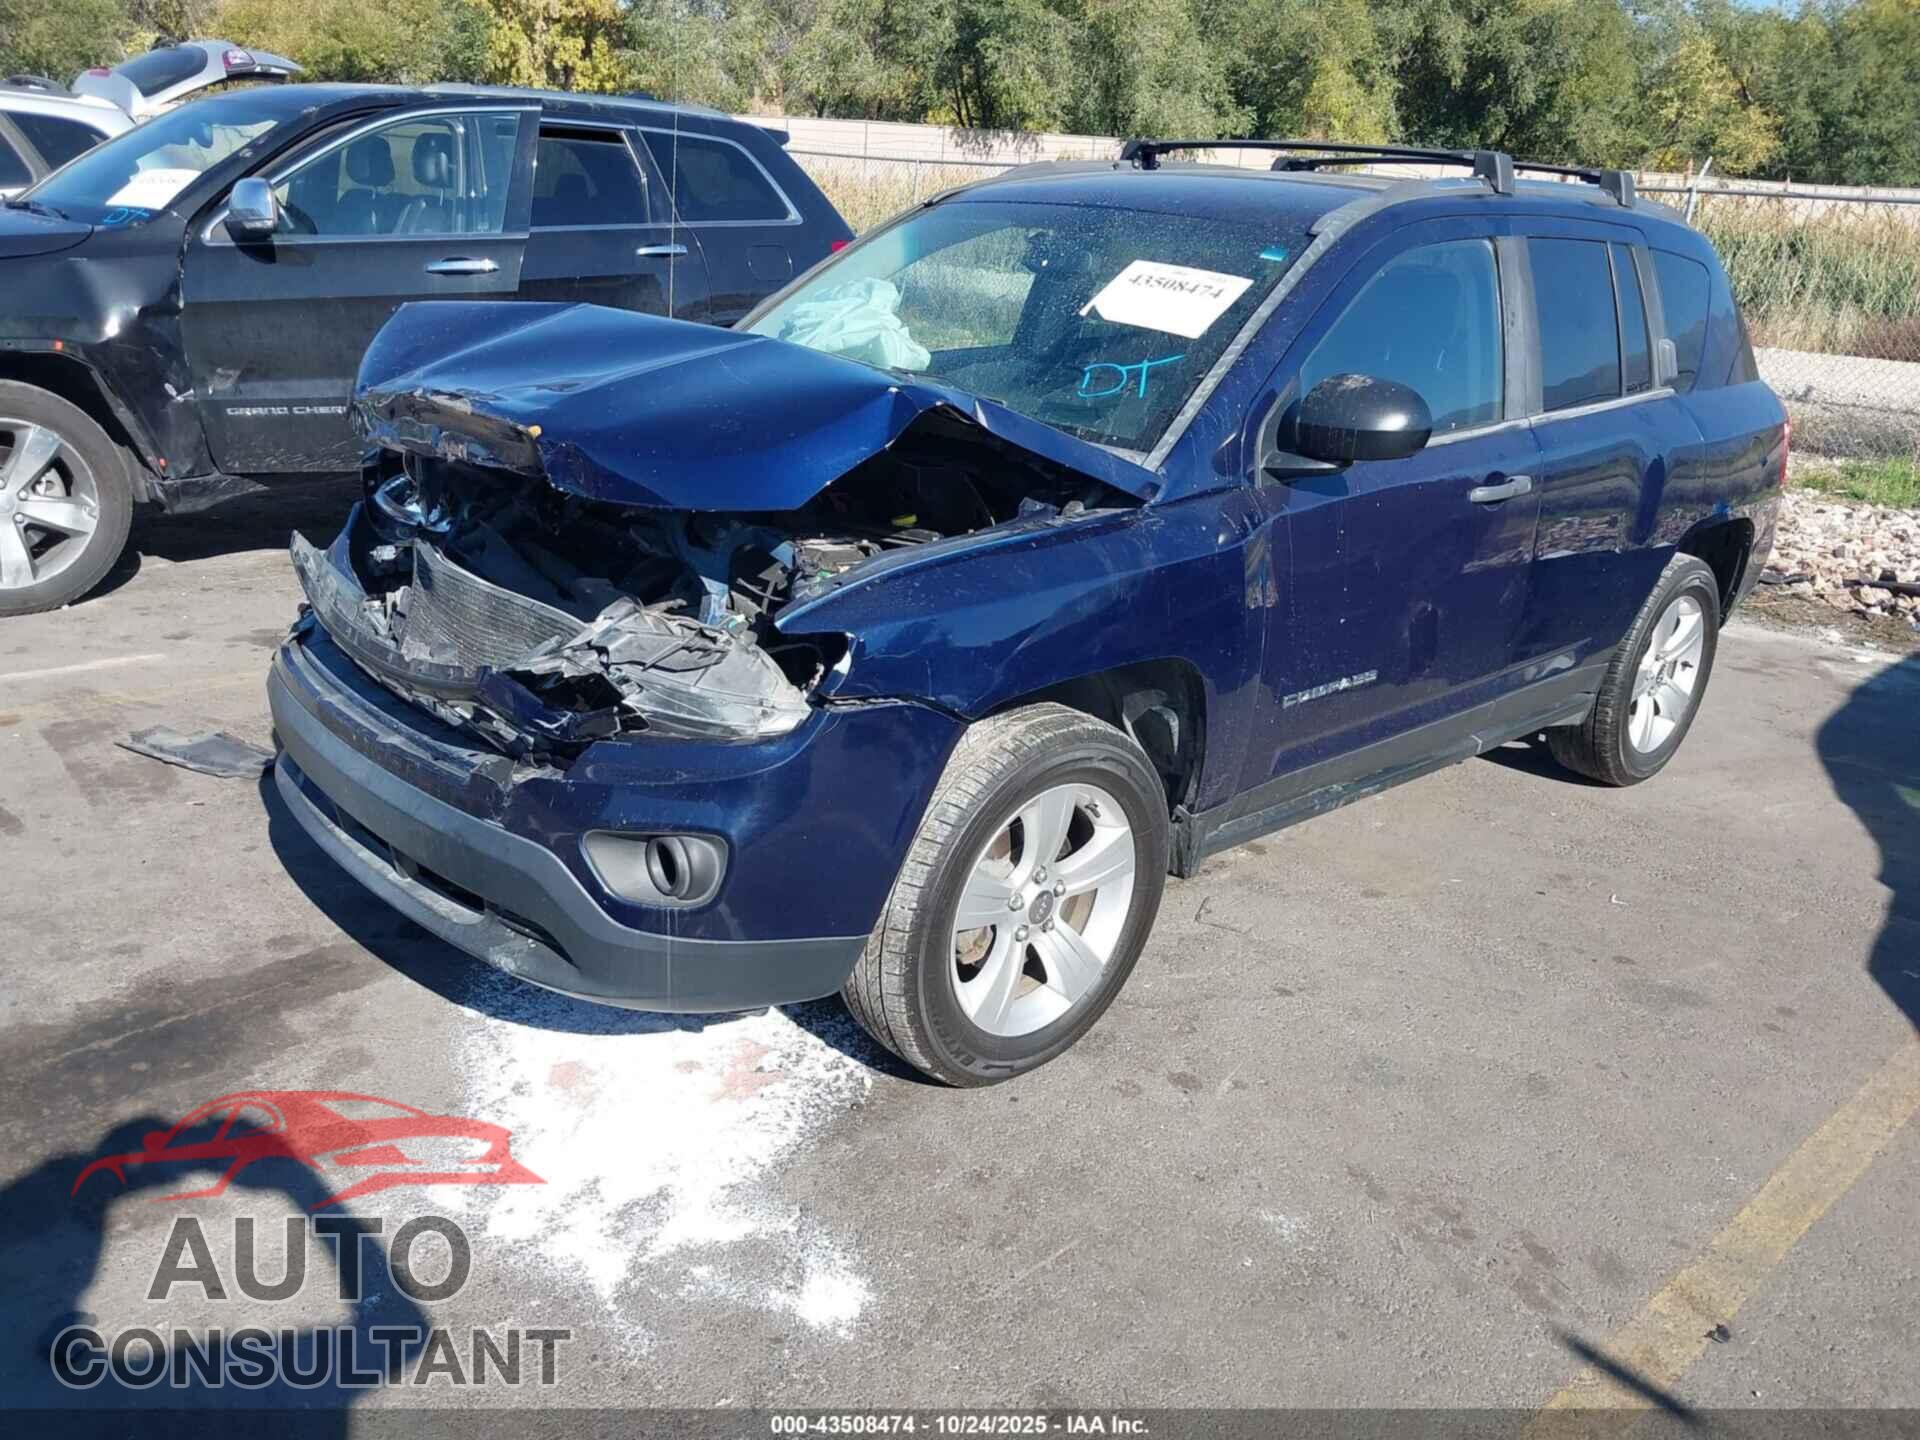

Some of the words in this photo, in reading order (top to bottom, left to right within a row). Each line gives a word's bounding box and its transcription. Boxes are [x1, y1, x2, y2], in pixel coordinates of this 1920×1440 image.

[1128, 274, 1224, 299] 43508474
[1077, 353, 1185, 399] DT
[226, 406, 288, 416] GRAND
